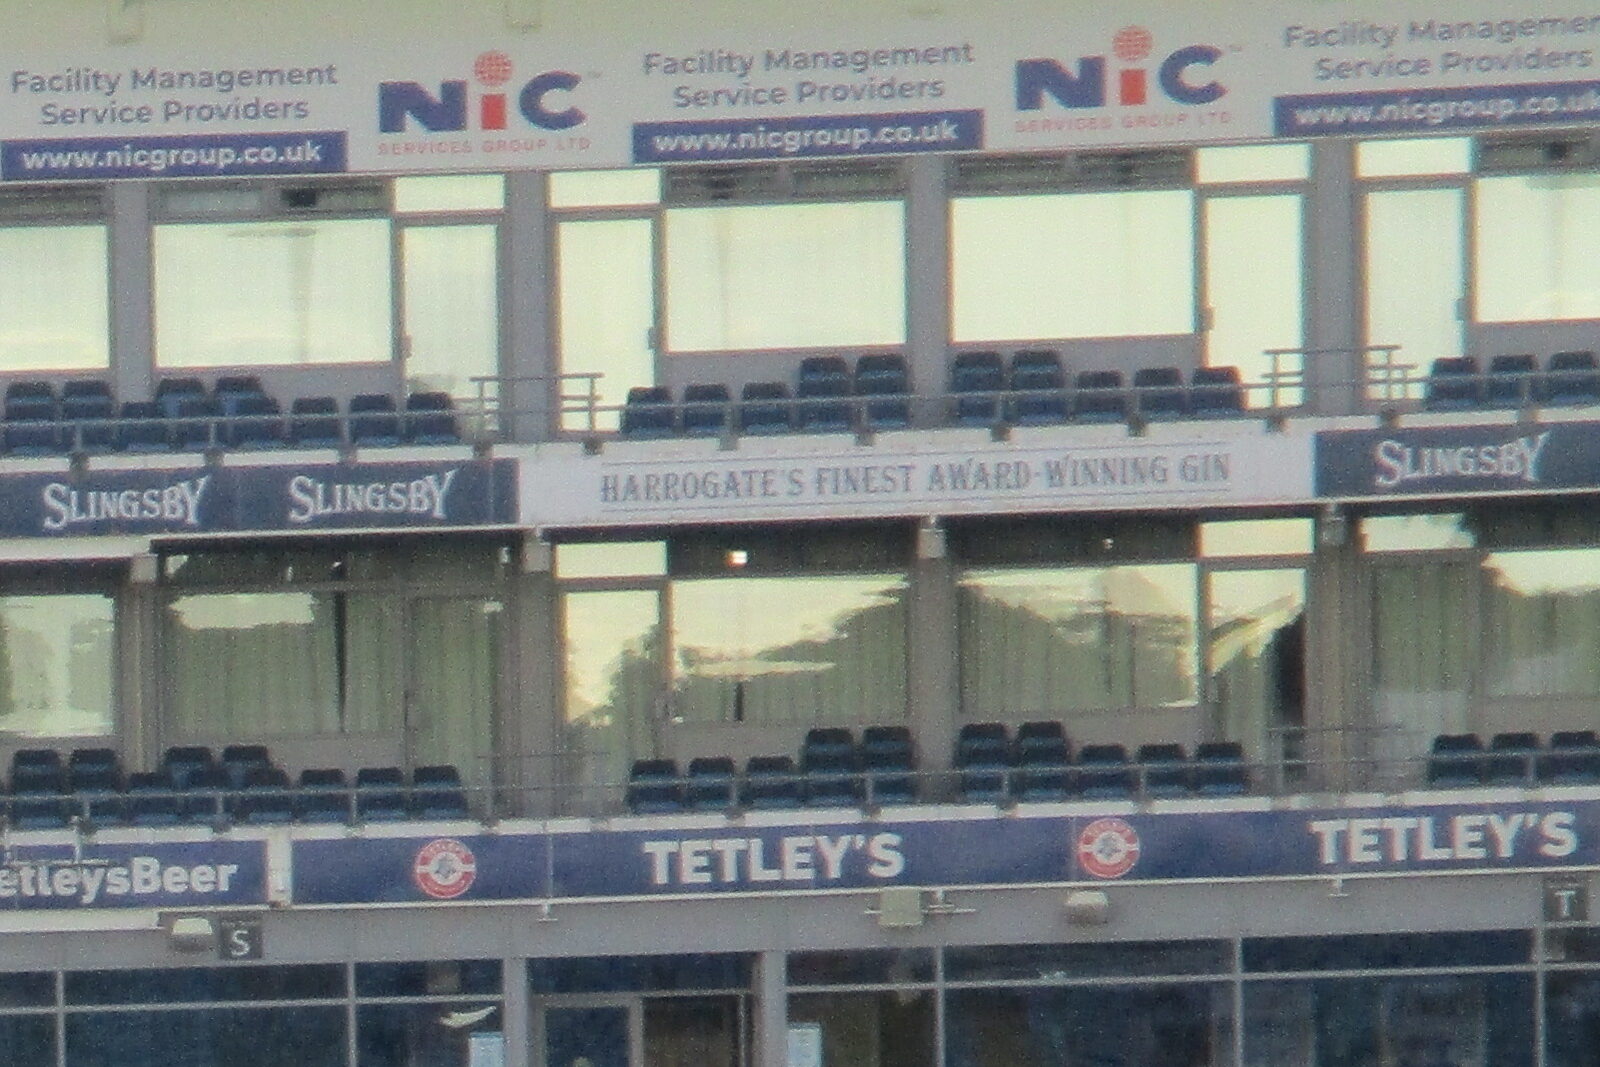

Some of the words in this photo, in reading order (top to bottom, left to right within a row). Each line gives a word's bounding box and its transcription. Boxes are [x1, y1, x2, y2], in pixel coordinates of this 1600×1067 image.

[1284, 23, 1399, 48] Facility
[643, 49, 754, 76] Facility
[763, 42, 976, 71] Management
[1314, 55, 1432, 80] Service
[1441, 47, 1593, 75] Providers
[10, 67, 121, 94] Facility
[131, 63, 339, 90] Management
[673, 82, 786, 108] Service
[797, 75, 945, 102] Providers
[40, 102, 153, 126] Service
[163, 95, 310, 122] Providers
[377, 140, 473, 155] SERVICES
[652, 118, 961, 154] www.nicgroup.co.uk
[21, 138, 322, 173] www.nicgroup.co.uk
[601, 468, 804, 501] HARROGATE'S
[815, 463, 917, 495] FINEST
[1179, 452, 1232, 482] GIN
[1373, 431, 1552, 488] SLINGSBY
[41, 474, 211, 530] SLINGSBY
[287, 468, 459, 523] SLINGSBY
[1307, 811, 1579, 866] TETLEY'S
[642, 831, 907, 887] TETLEY'S
[230, 929, 251, 956] S
